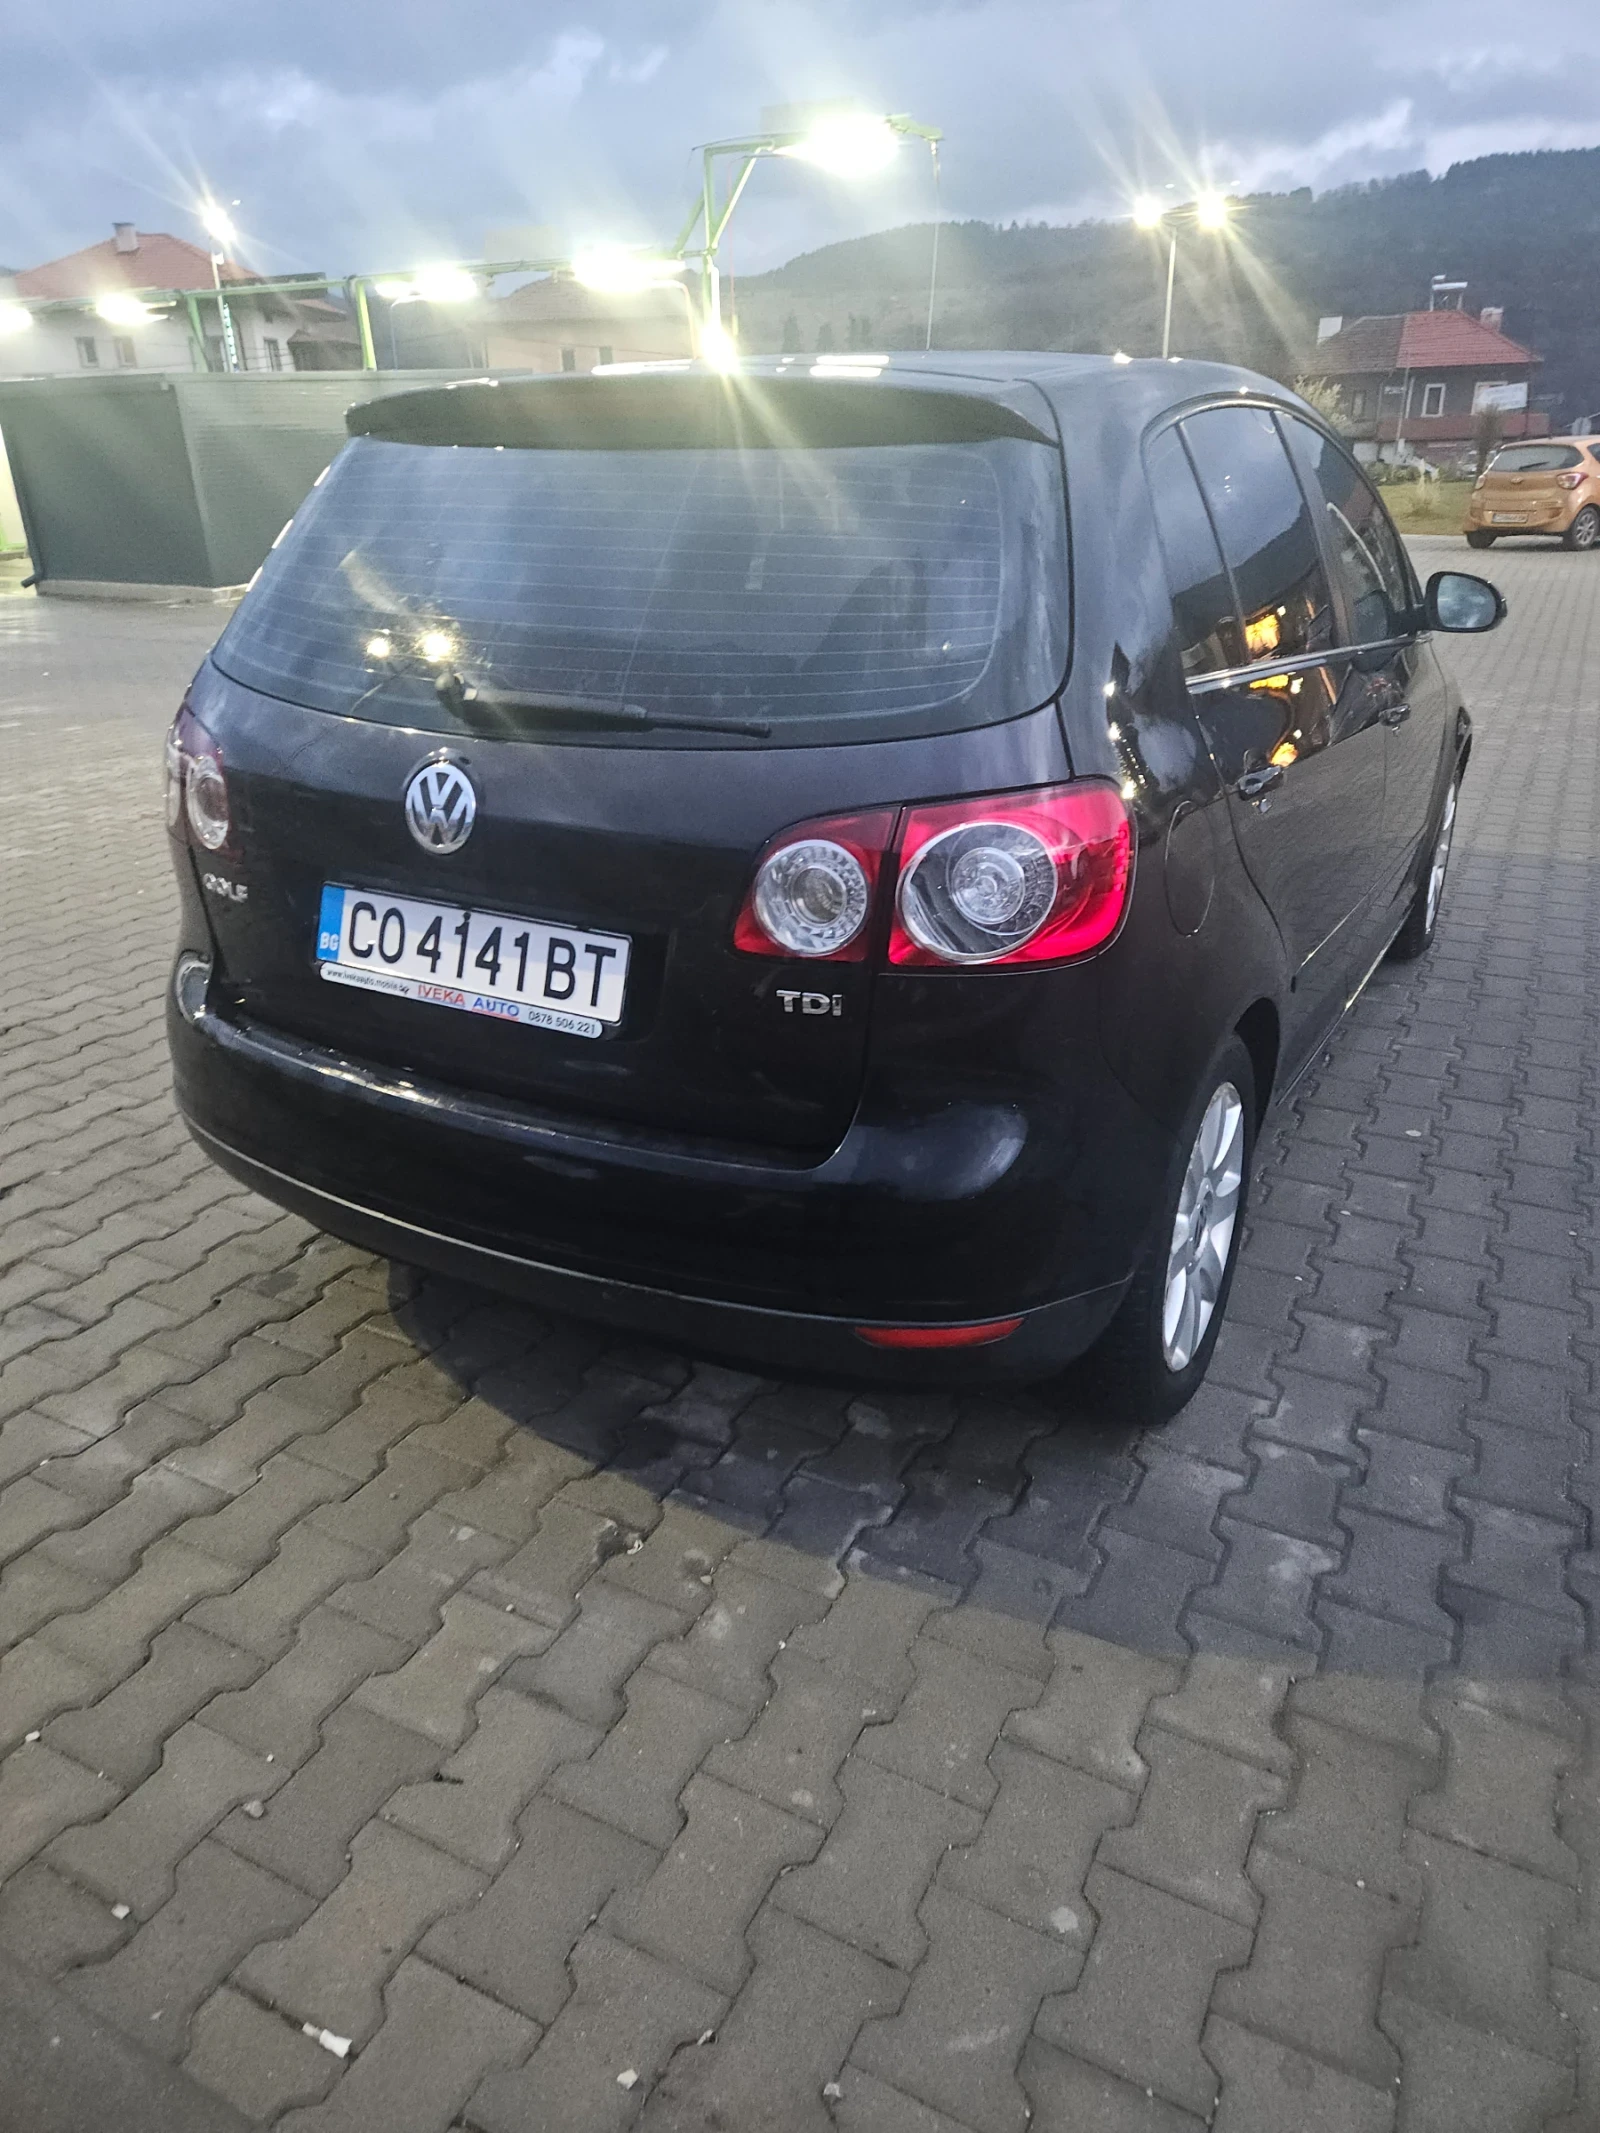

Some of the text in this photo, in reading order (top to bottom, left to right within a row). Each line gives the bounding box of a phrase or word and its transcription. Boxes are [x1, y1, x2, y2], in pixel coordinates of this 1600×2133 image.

[320, 932, 339, 951] BG
[417, 984, 466, 1006] IVEKA
[473, 997, 520, 1018] AUTO
[528, 1010, 553, 1026] 0878
[576, 1021, 596, 1035] 221
